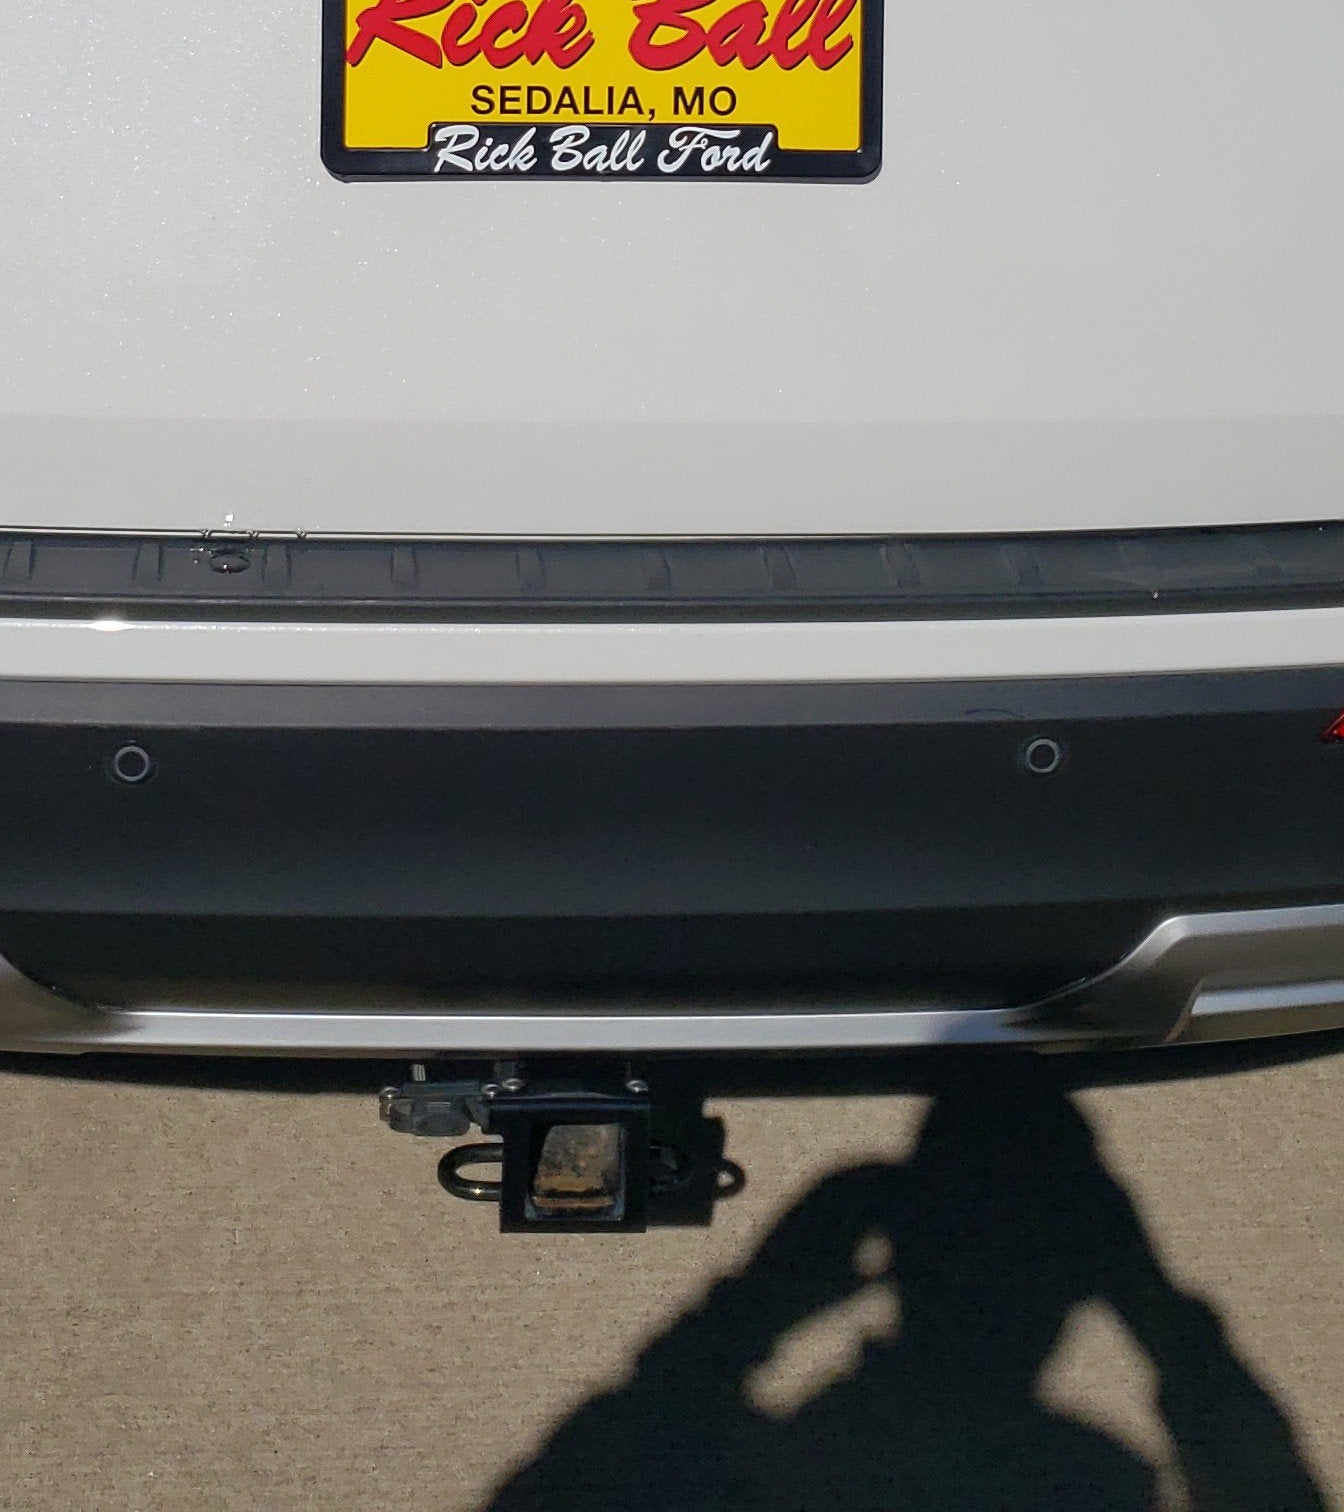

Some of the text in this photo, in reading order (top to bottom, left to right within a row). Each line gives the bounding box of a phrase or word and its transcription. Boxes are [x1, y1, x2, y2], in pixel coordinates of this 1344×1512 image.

[470, 85, 737, 121] SEDALIA, MO
[433, 124, 773, 174] Rick Ball Ford
